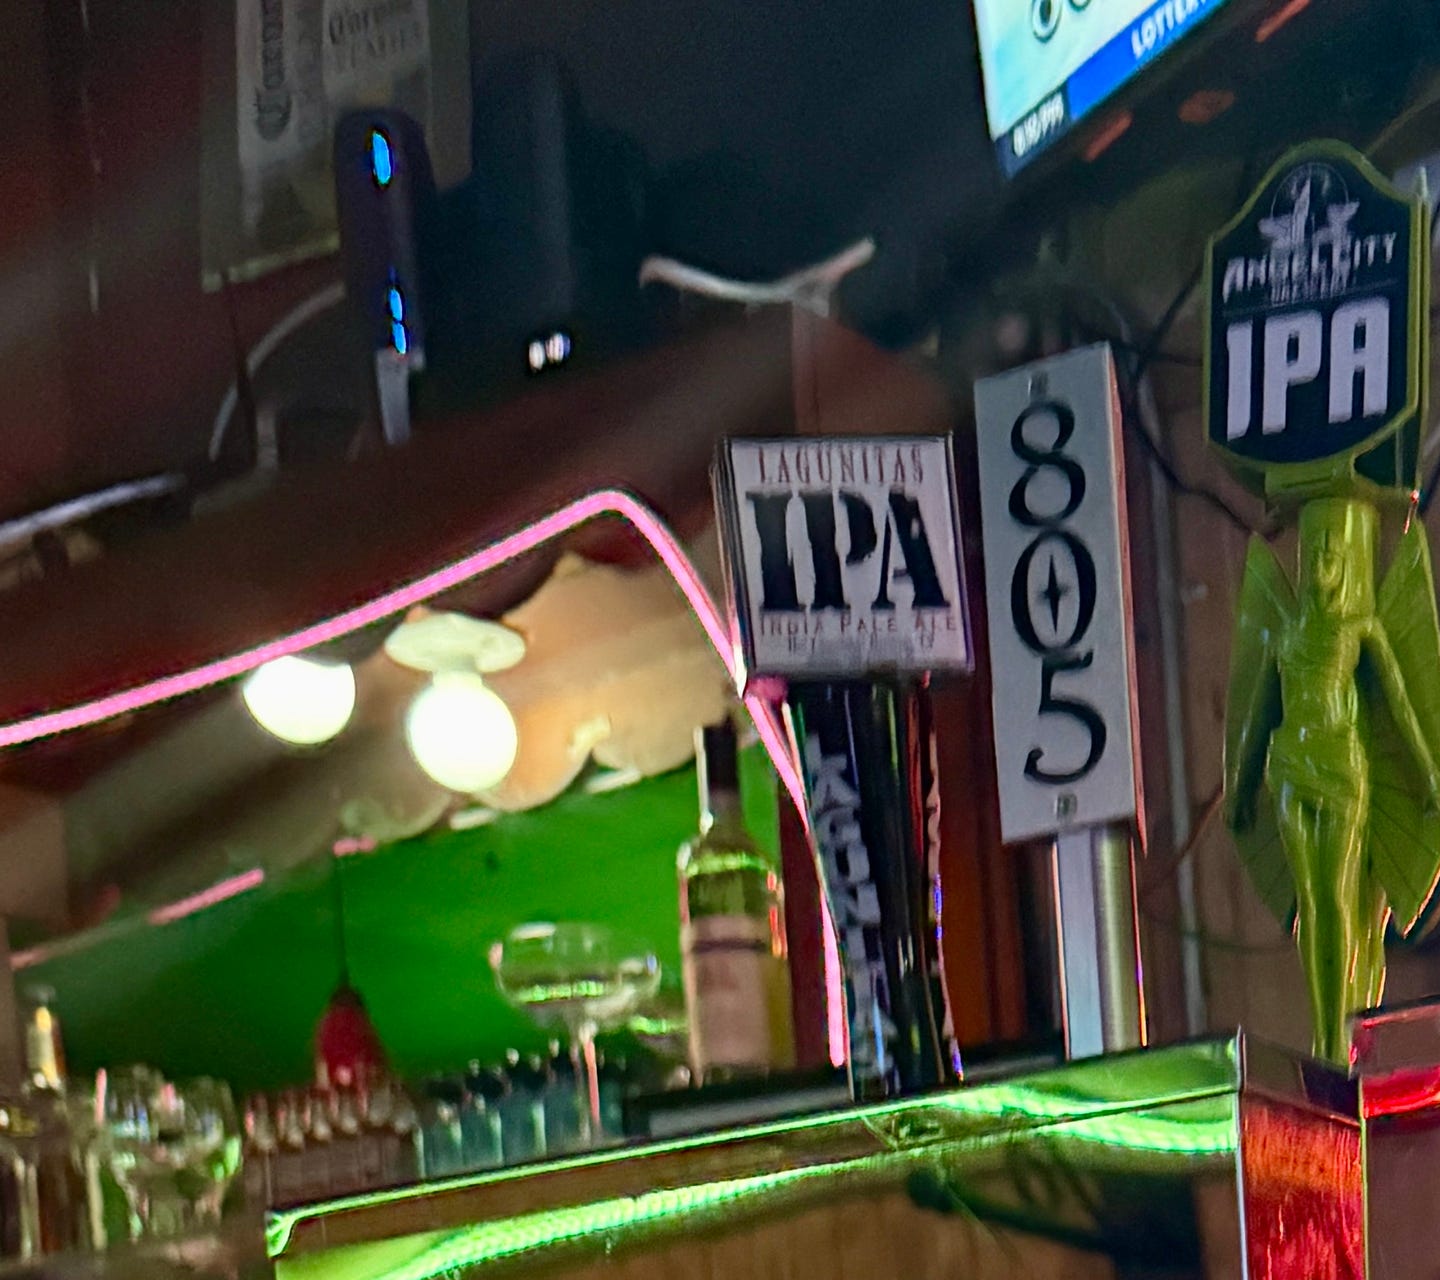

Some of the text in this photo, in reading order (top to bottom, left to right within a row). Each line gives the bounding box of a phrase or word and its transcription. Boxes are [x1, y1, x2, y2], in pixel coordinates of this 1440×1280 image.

[1226, 297, 1390, 441] IPA
[758, 444, 924, 484] LAGUNITAS
[745, 490, 951, 611] IPA
[1008, 401, 1107, 785] 805
[760, 609, 958, 637] INDIA PALE ALE
